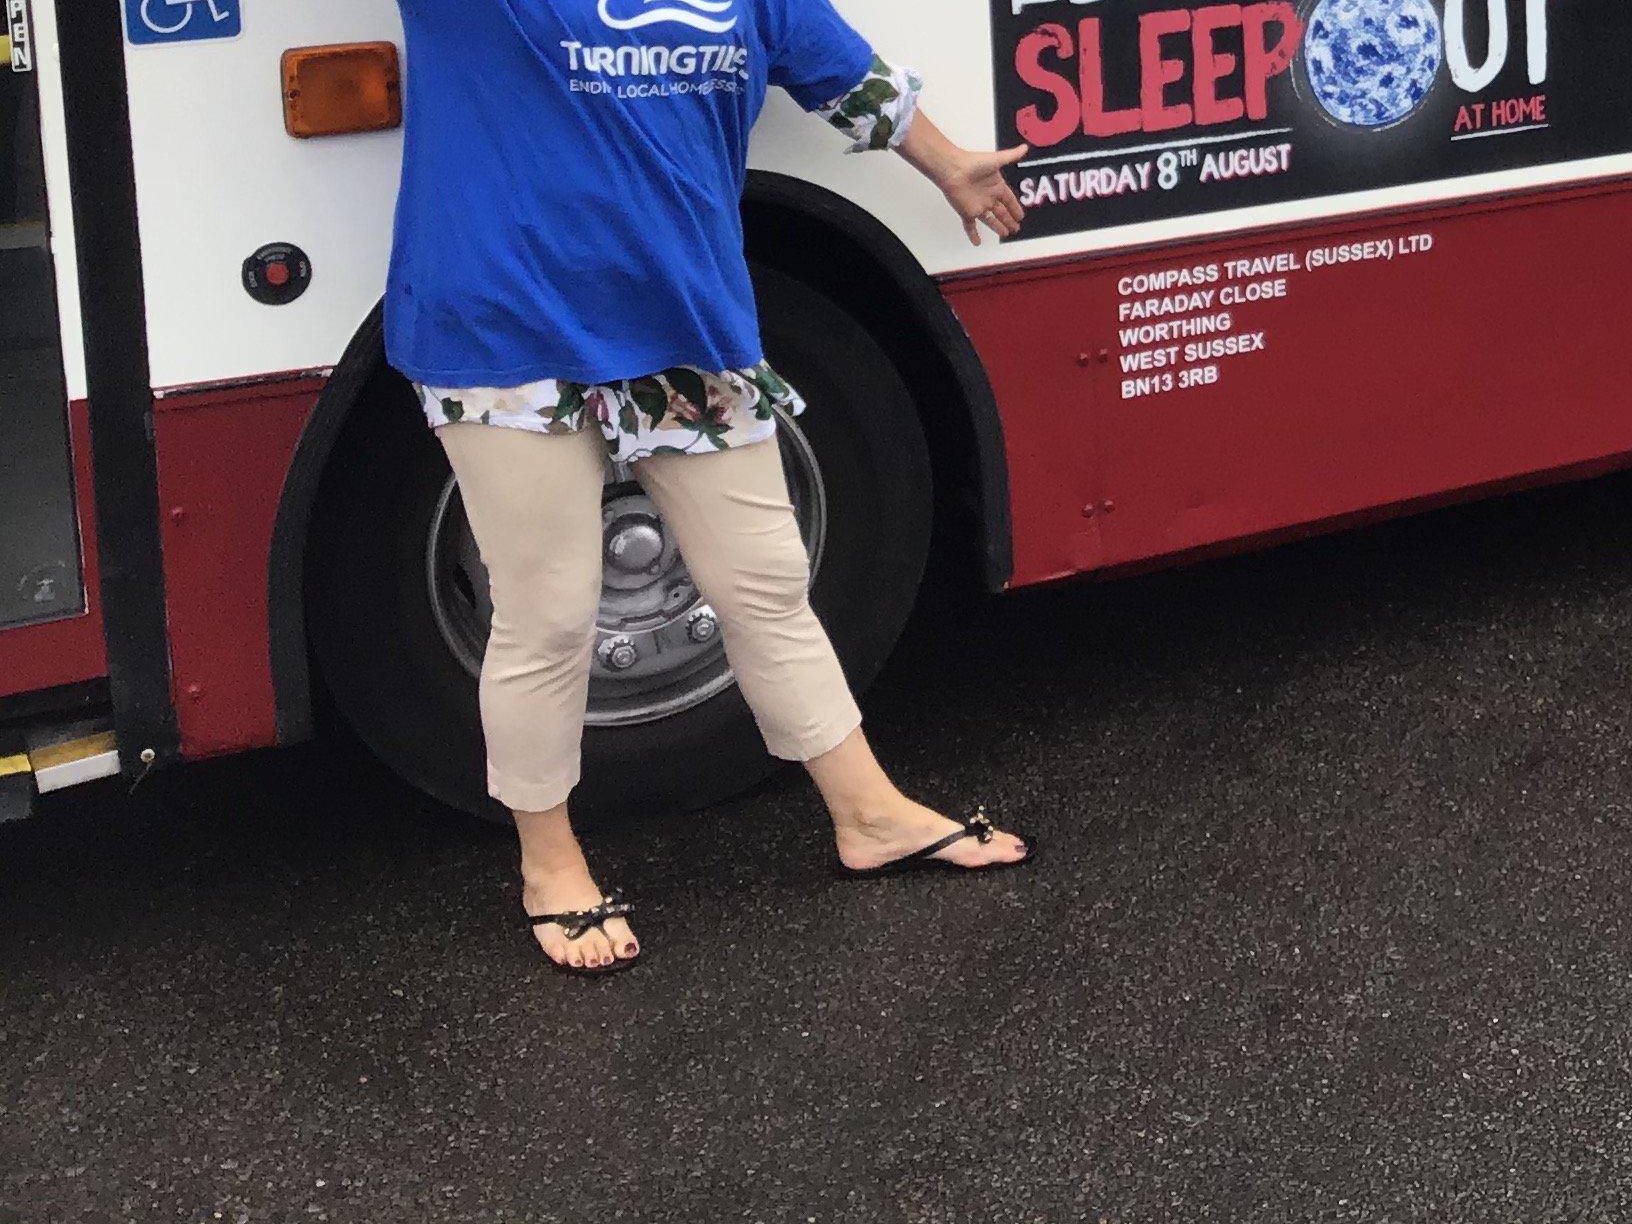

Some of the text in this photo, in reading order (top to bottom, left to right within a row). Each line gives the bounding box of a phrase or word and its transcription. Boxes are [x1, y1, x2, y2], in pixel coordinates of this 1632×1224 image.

[617, 84, 669, 99] LOCAL
[1453, 94, 1546, 132] AT HOME
[1019, 161, 1152, 208] SATURDAY
[1199, 143, 1293, 184] AUGUST
[1117, 233, 1433, 296] COMPASS TRAVEL (SUSSEX) LTD
[1118, 279, 1287, 322] FARADAY CLOSE
[1118, 312, 1231, 347] WORTHING
[1119, 331, 1265, 373] WEST SUSSEX
[1120, 365, 1218, 399] BN13 3RB
